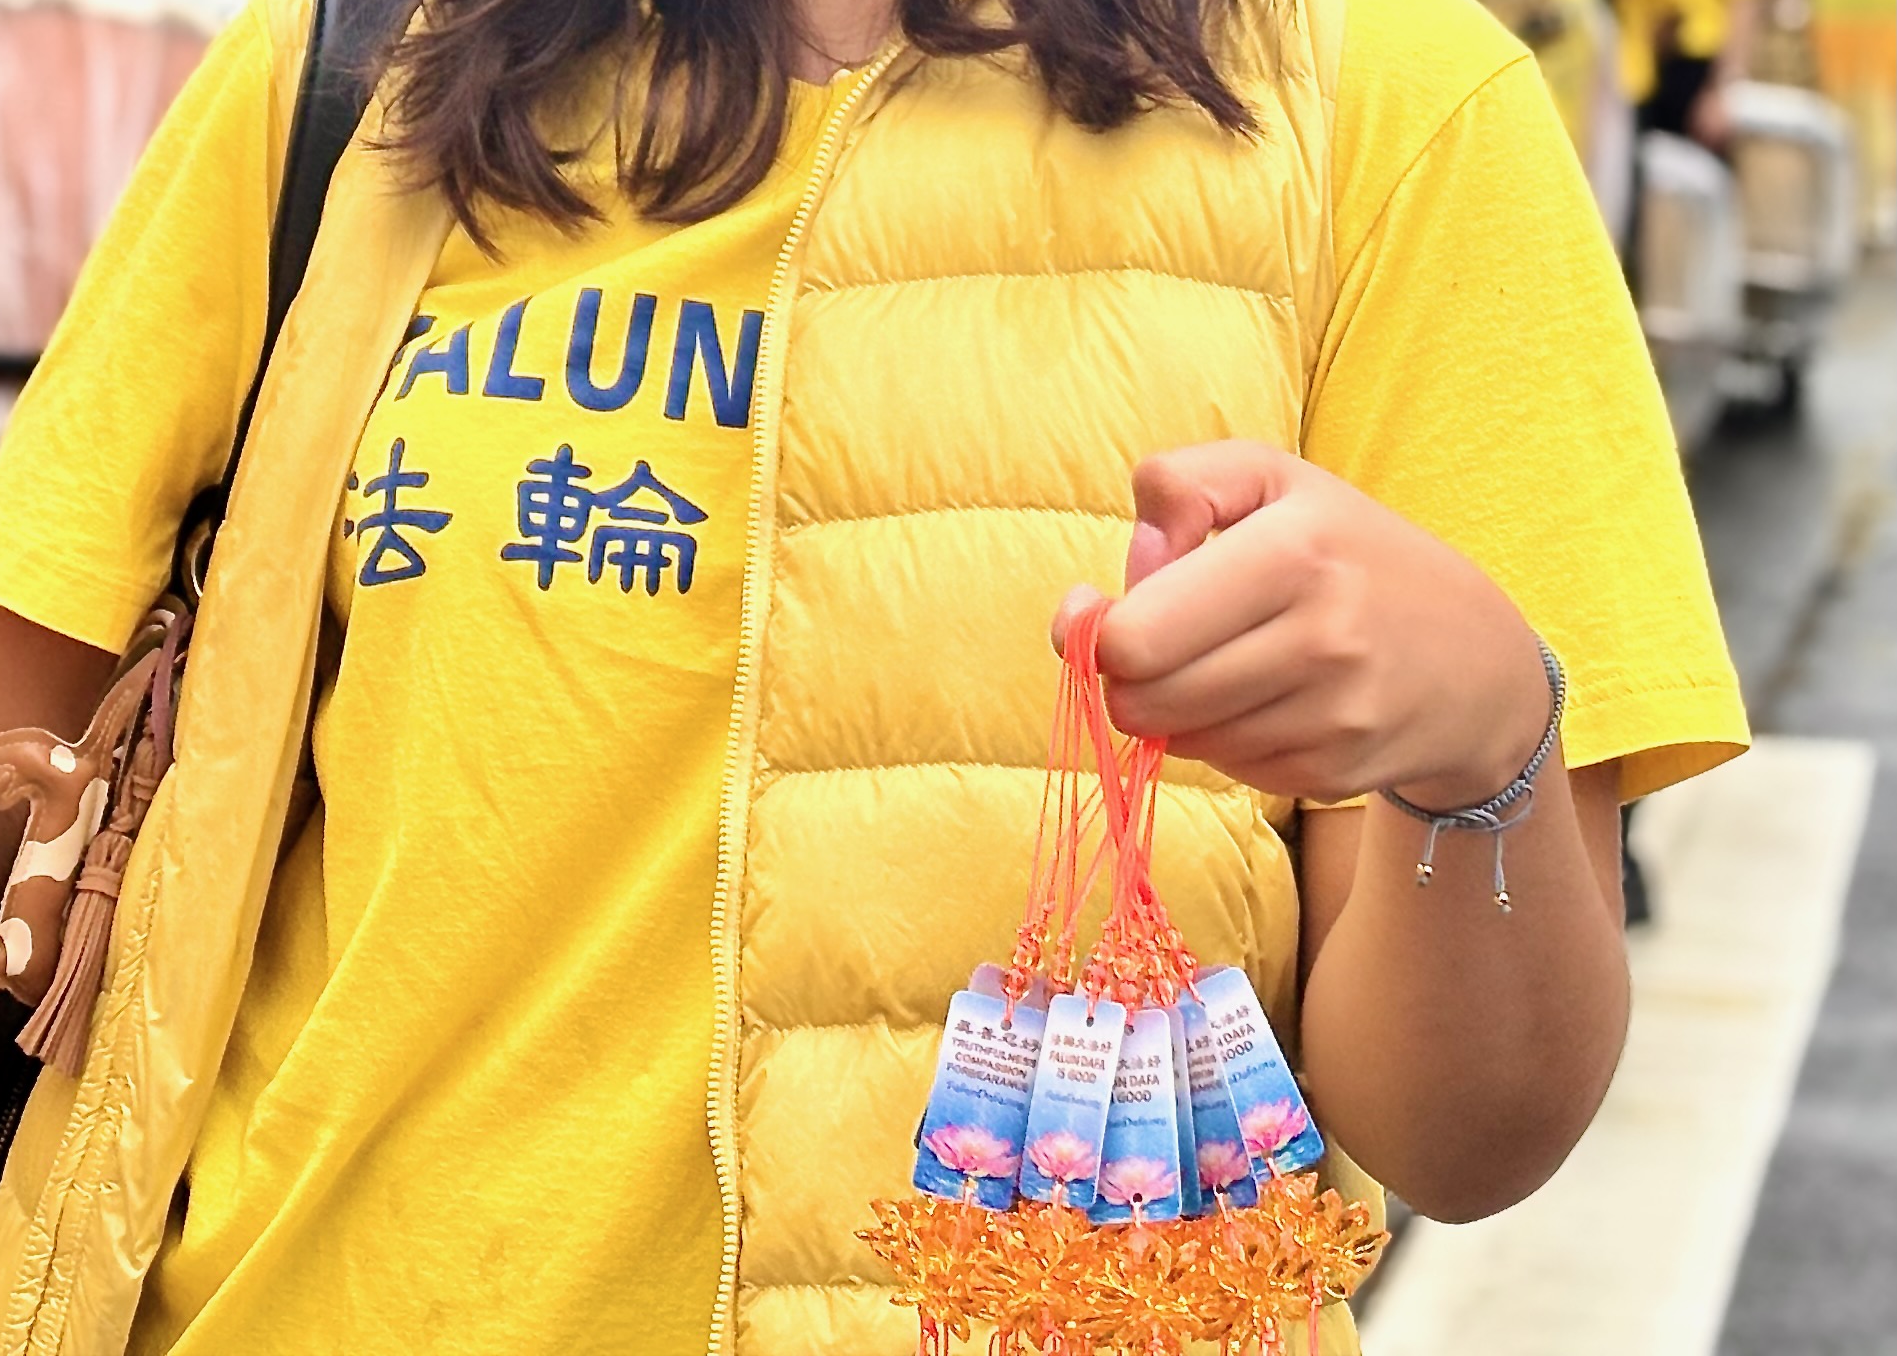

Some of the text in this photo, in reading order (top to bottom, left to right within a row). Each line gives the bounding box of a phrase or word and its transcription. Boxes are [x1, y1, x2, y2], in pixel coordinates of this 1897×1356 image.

[394, 288, 765, 428] ALUN
[1223, 1023, 1256, 1045] DAFA
[955, 1052, 1028, 1079] COMPASSION
[1129, 1074, 1160, 1087] DAFA
